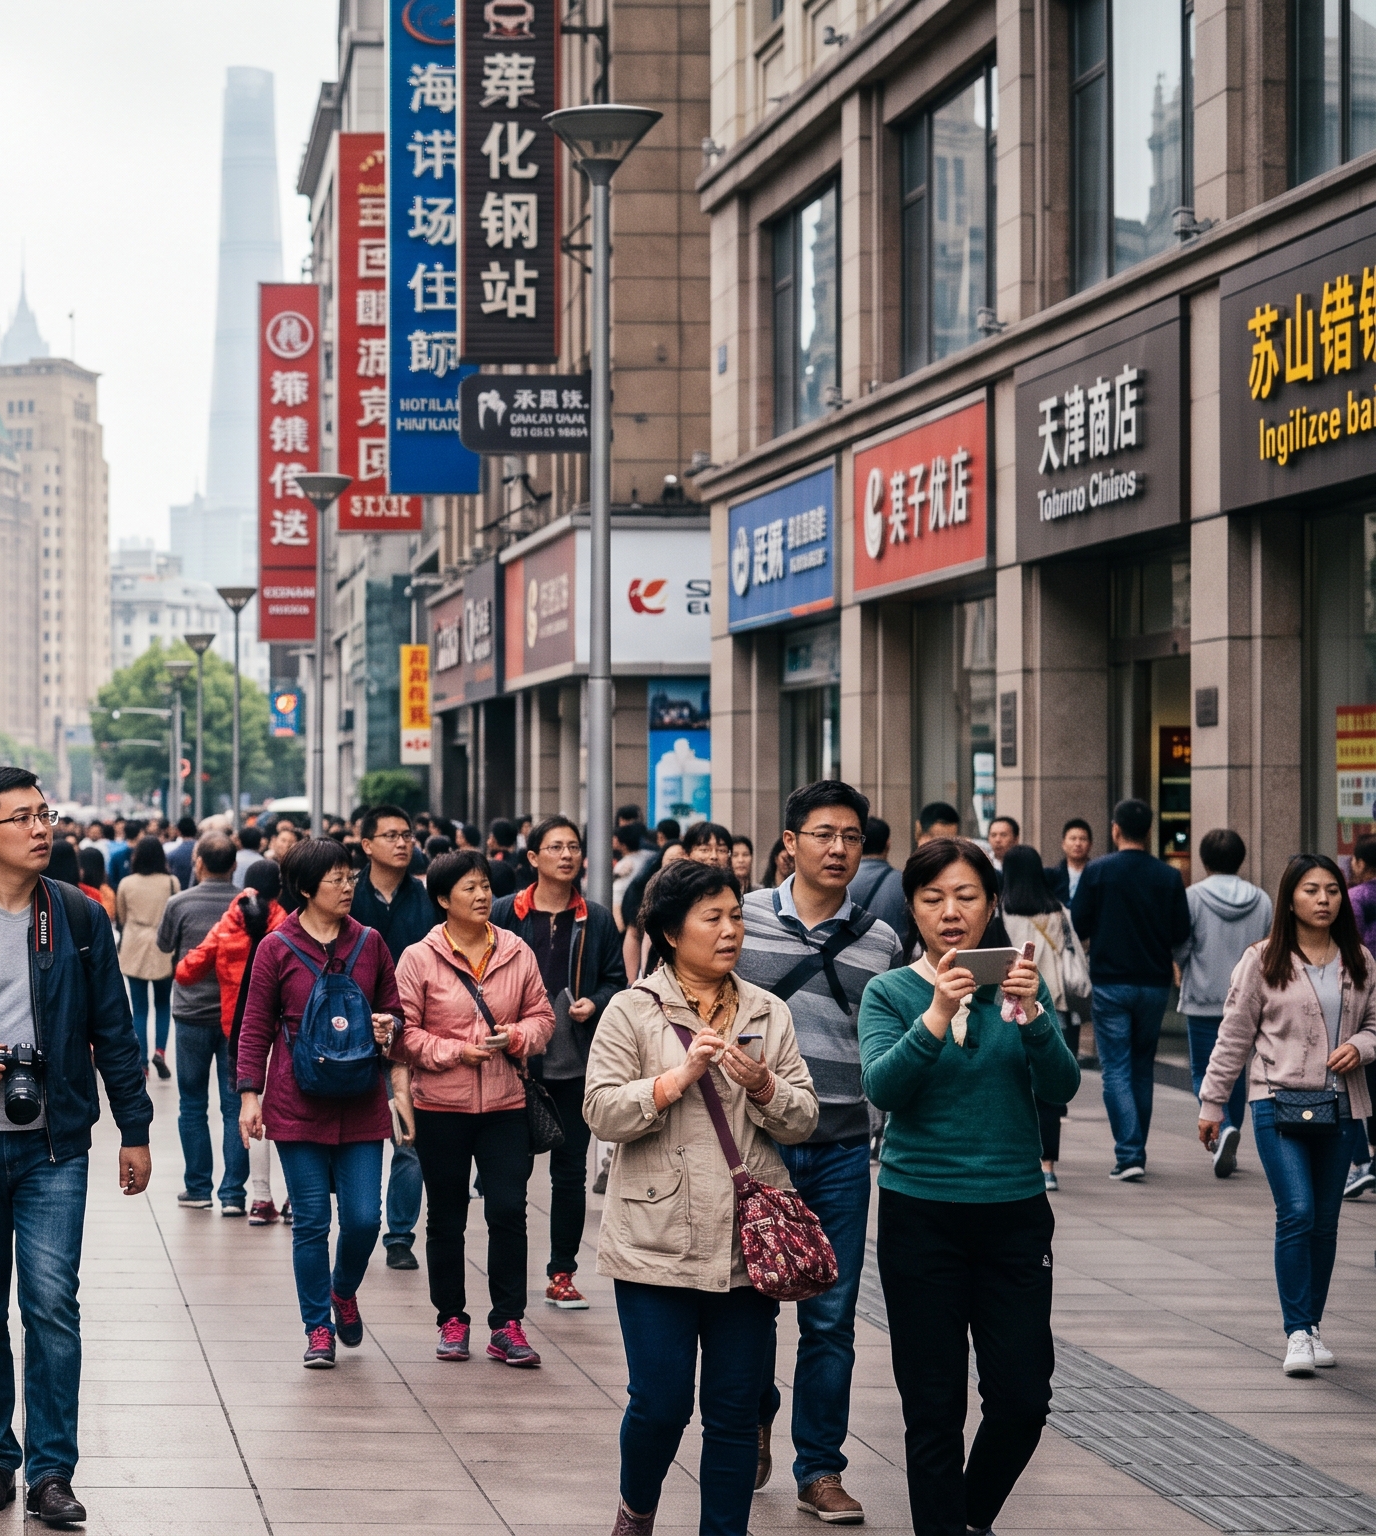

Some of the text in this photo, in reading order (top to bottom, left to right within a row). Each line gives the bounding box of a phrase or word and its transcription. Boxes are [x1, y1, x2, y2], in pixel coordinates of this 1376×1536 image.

[1038, 364, 1138, 475] 天津商店
[1259, 406, 1341, 466] Ingilizce
